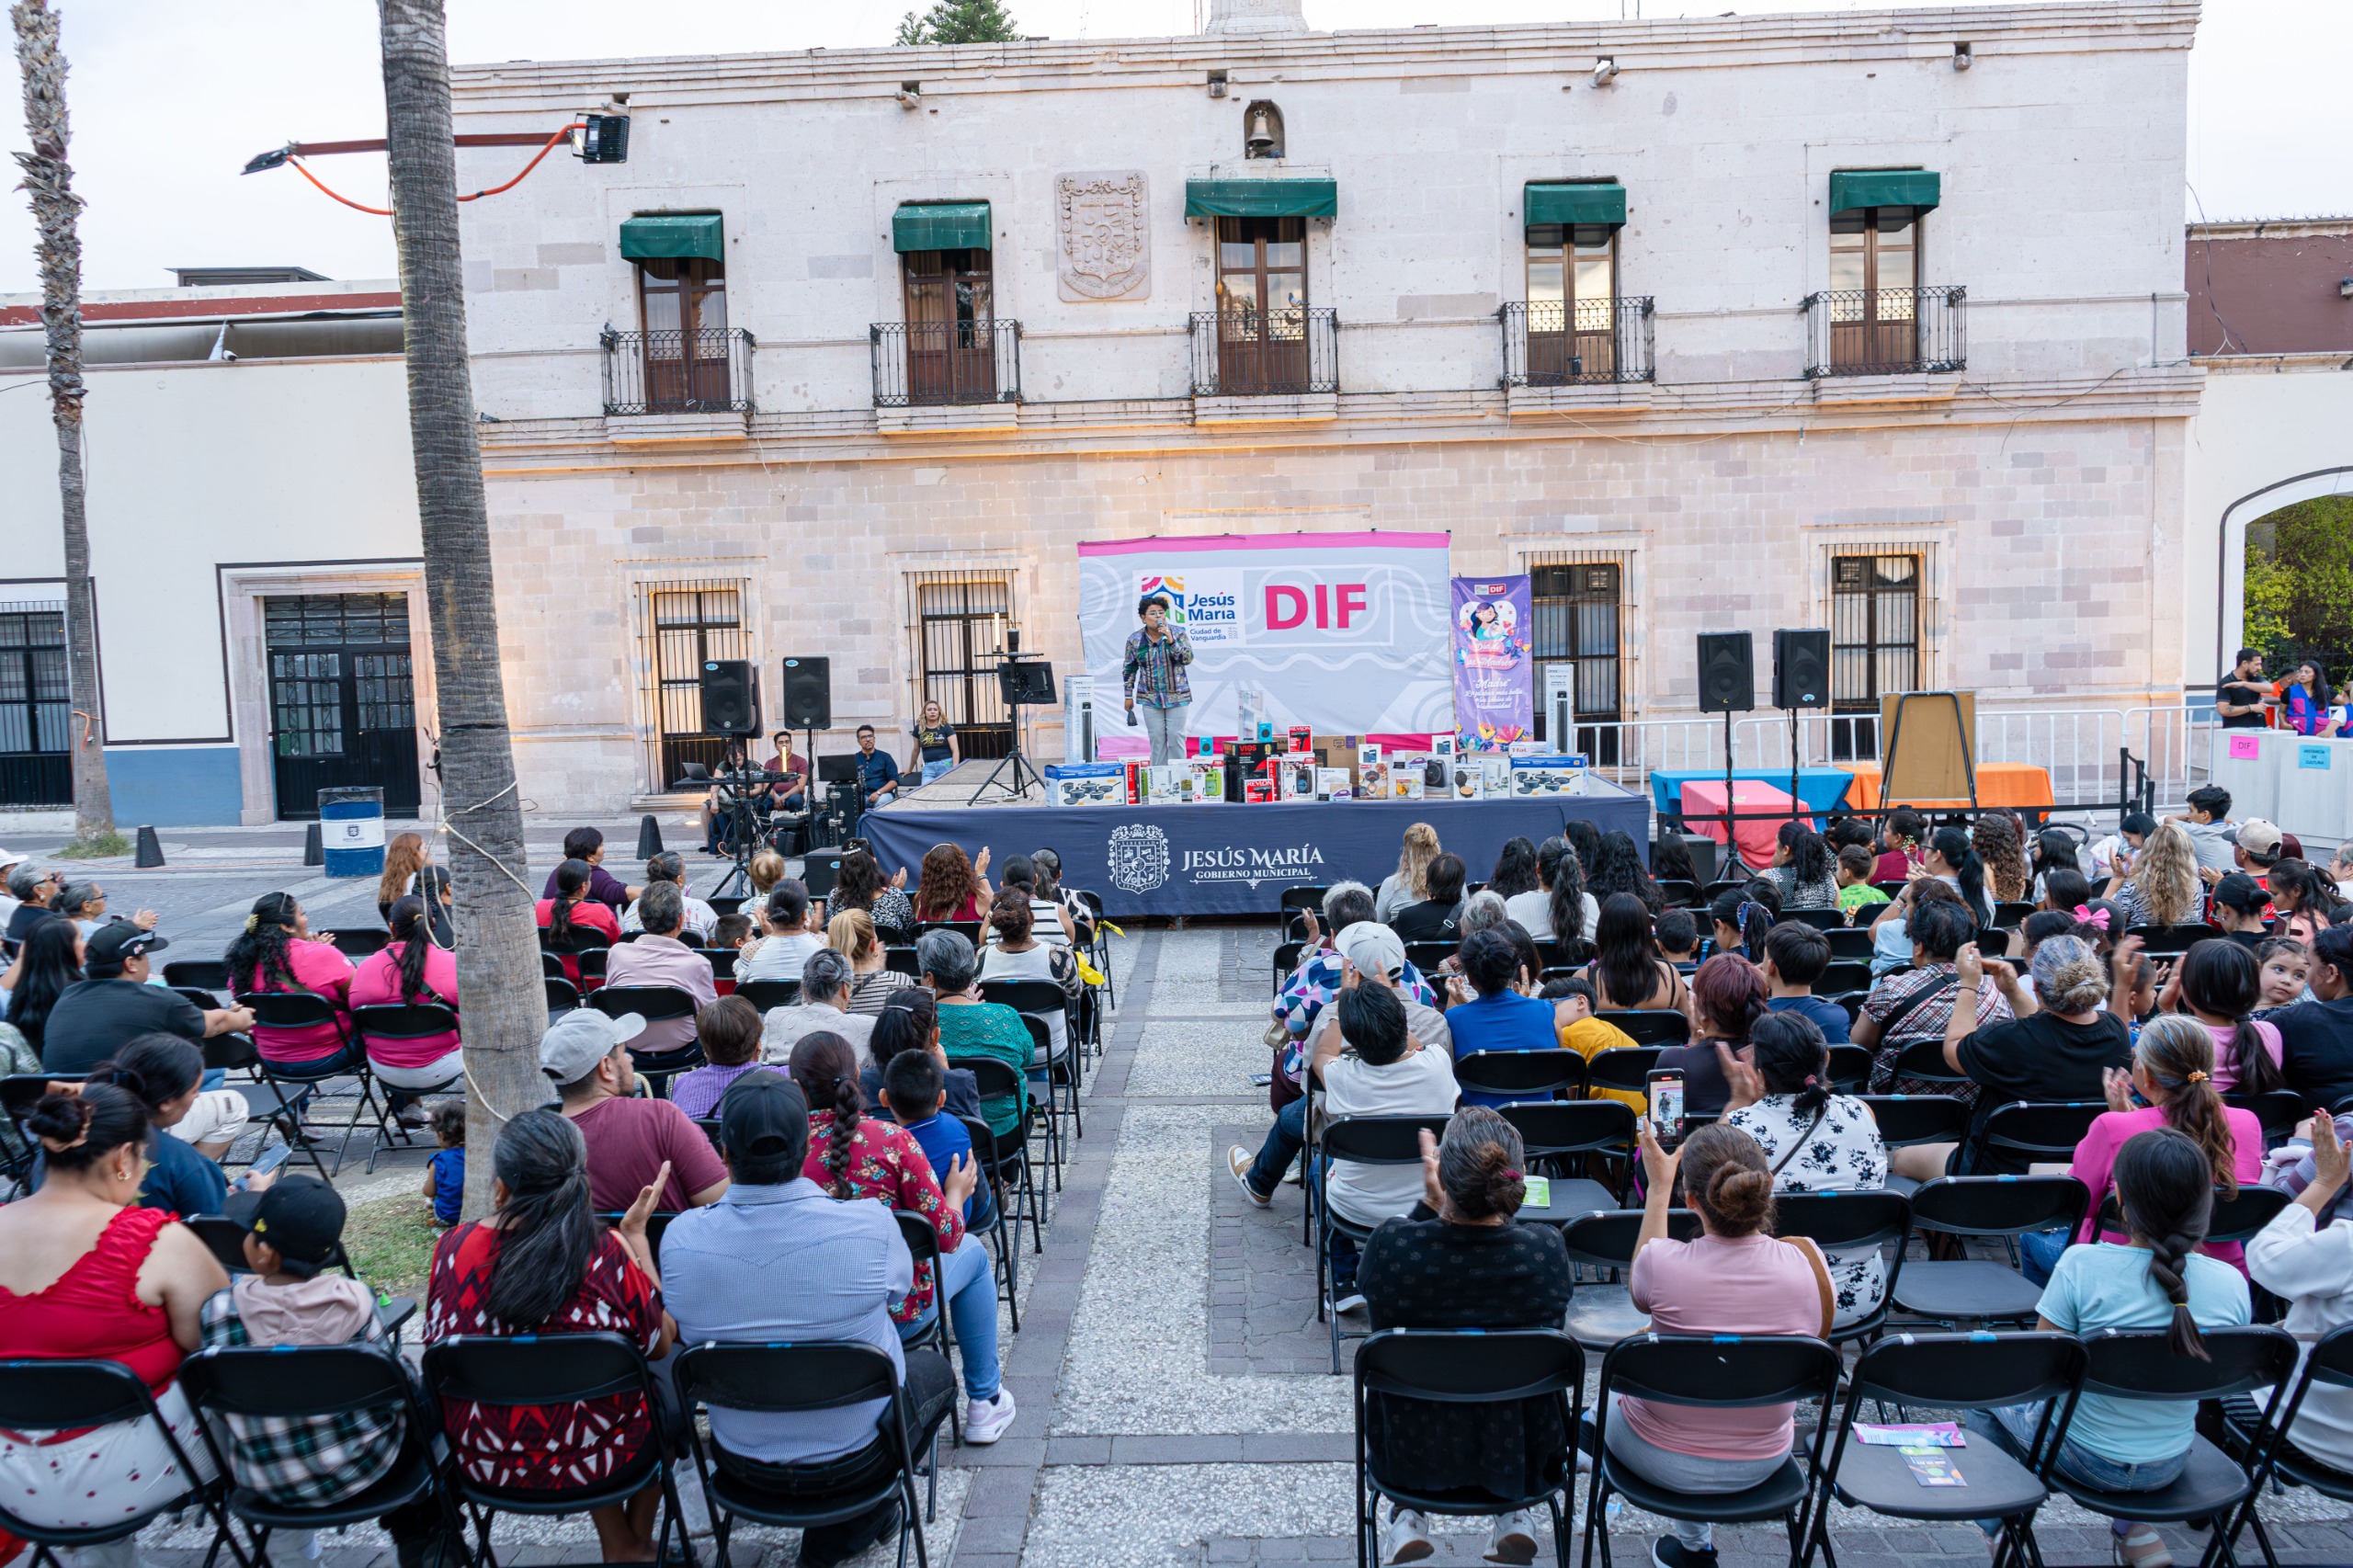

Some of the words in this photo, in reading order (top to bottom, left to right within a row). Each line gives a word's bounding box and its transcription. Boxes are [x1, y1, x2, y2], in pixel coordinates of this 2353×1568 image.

[1489, 585, 1505, 594] DIF
[1188, 591, 1235, 608] Jesús
[1188, 606, 1236, 621] María
[1265, 584, 1367, 631] DIF
[1190, 633, 1227, 642] Vanguardia
[1479, 656, 1513, 667] Madres
[2238, 742, 2251, 750] DIF
[1181, 846, 1245, 871] JESÚS
[1247, 843, 1325, 869] MARÍA
[1196, 869, 1250, 880] GOBIERNO
[1253, 868, 1311, 878] MUNICIPAL
